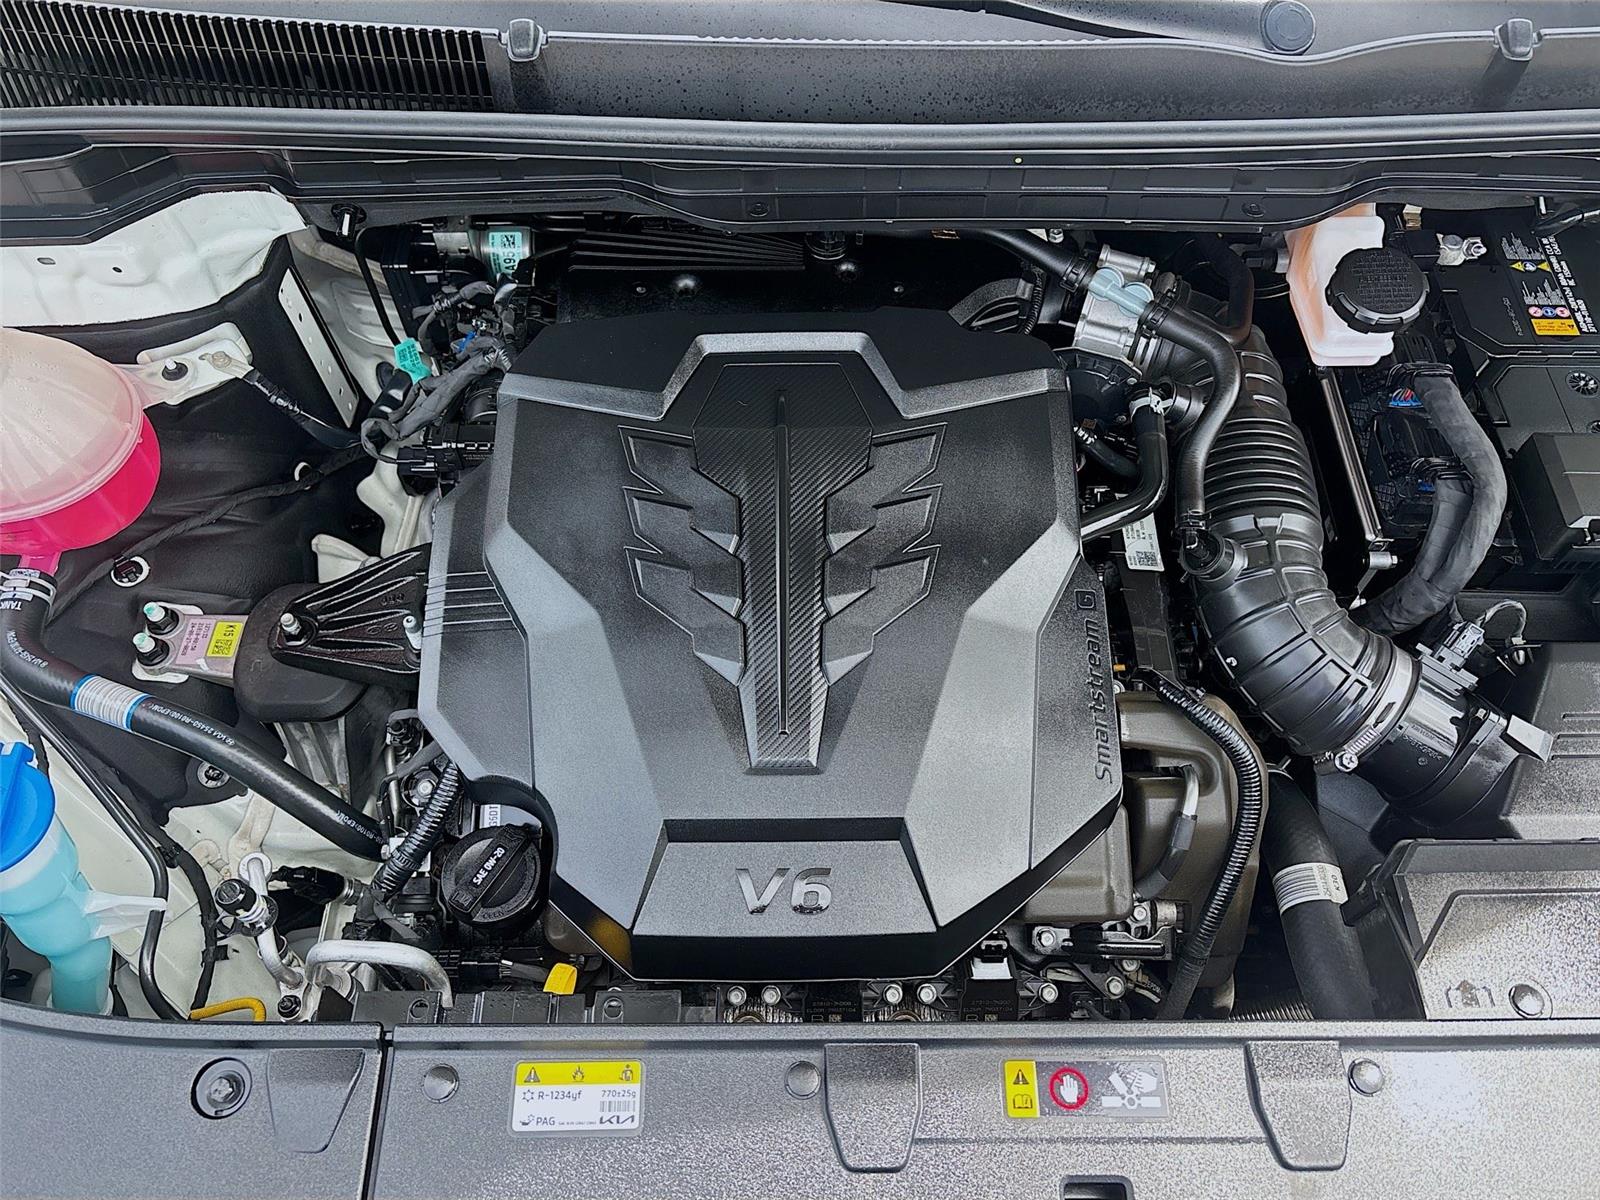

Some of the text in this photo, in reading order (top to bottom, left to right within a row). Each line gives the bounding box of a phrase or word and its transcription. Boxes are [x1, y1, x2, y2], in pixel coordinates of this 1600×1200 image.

[1084, 617, 1112, 784] Smartstream
[473, 847, 505, 885] SAE 0W-20
[735, 867, 832, 915] V6
[537, 1089, 636, 1101] R-1234yf 770±25g
[536, 1117, 555, 1126] PAG
[600, 1115, 635, 1124] KIA
